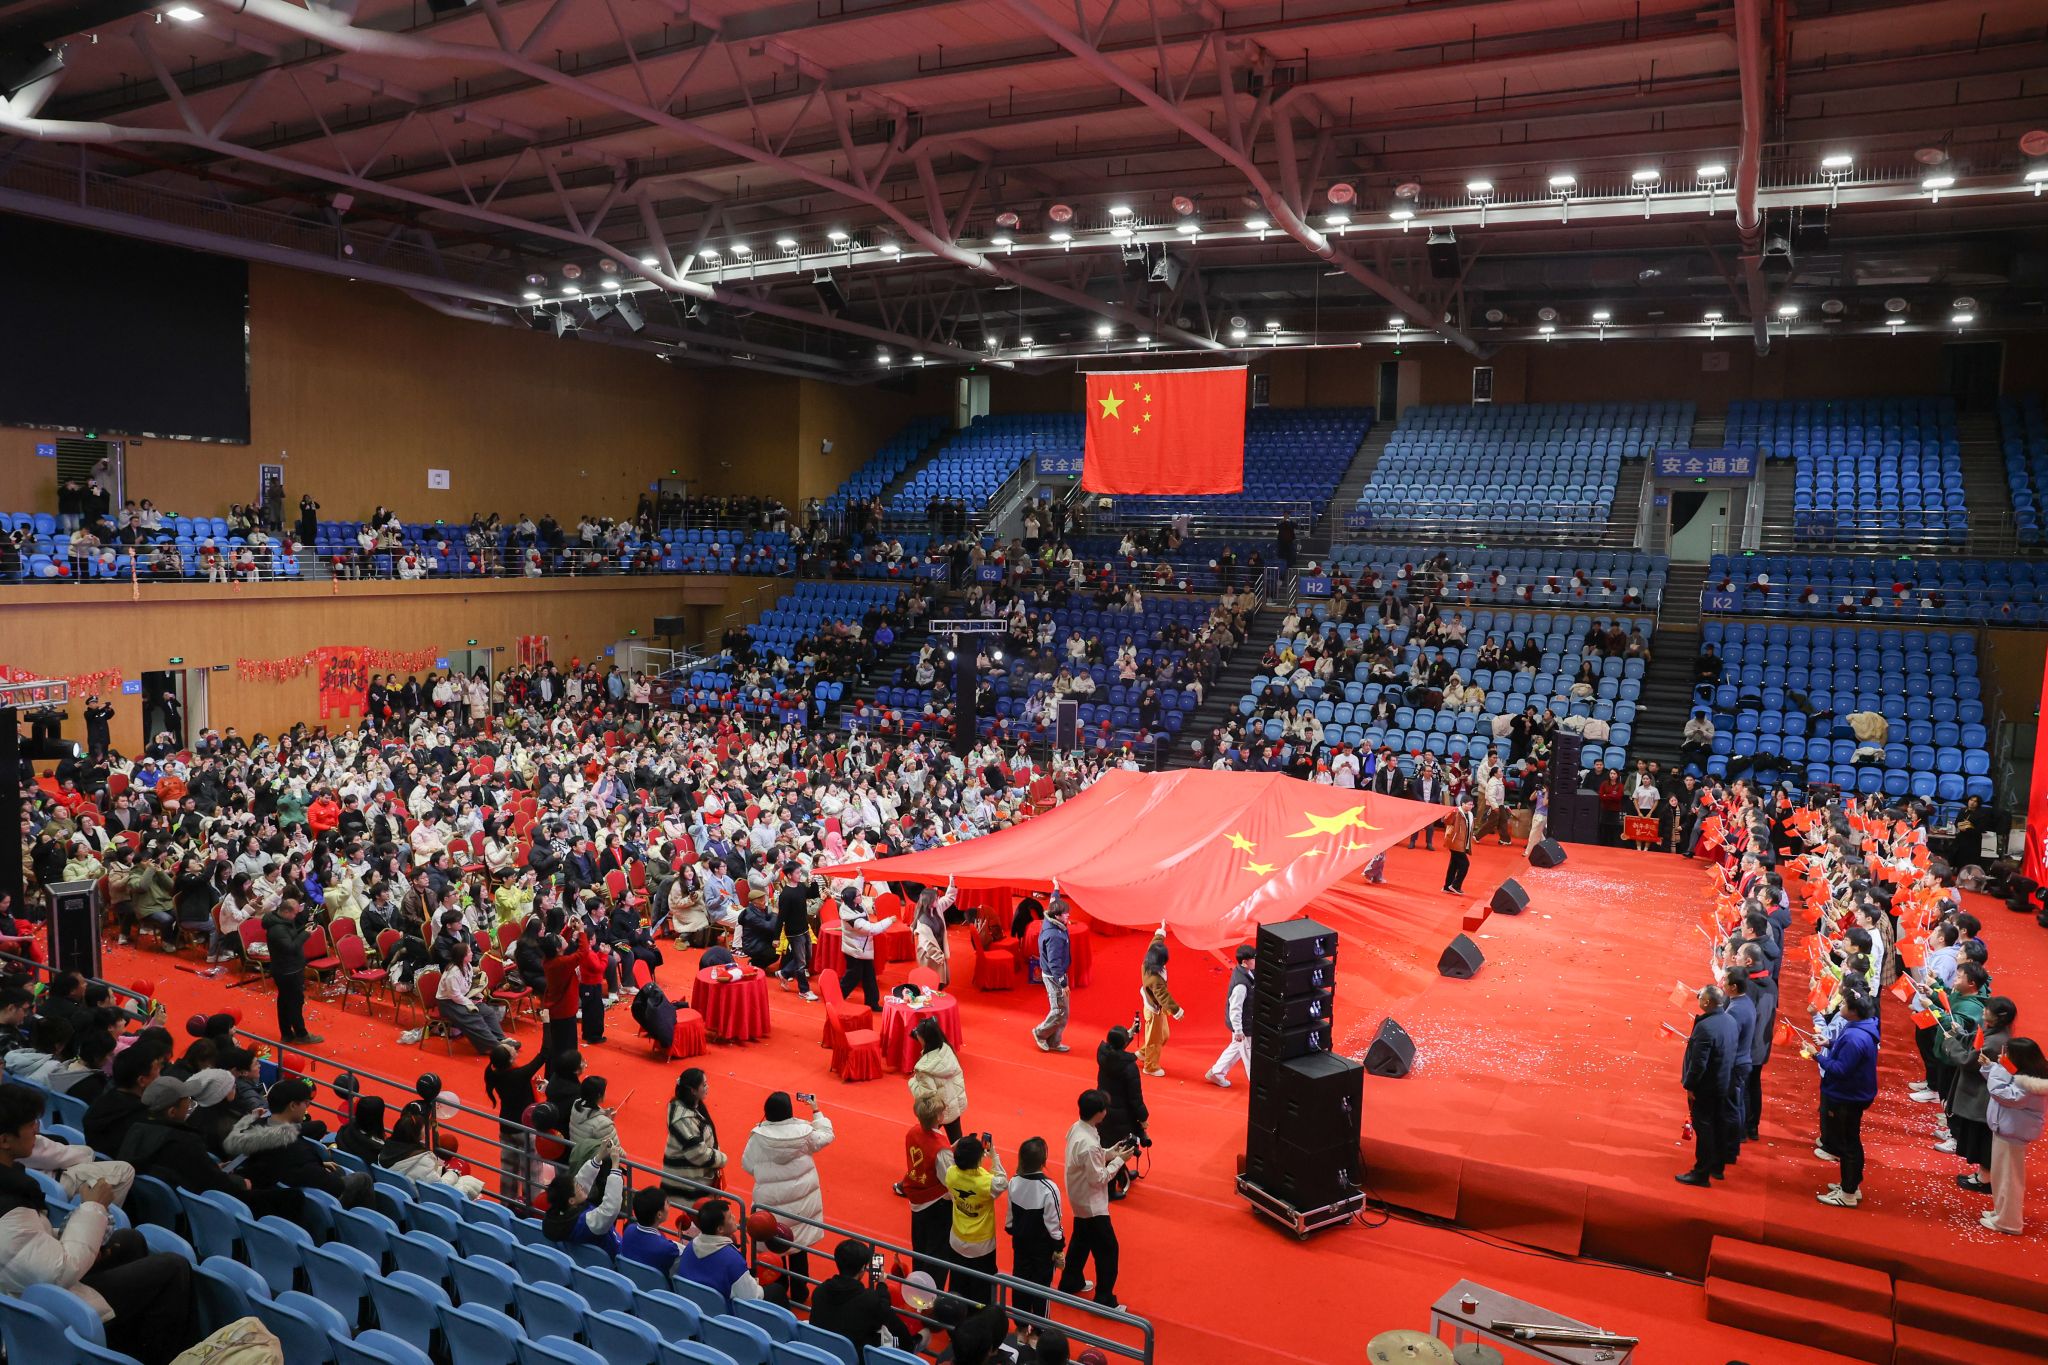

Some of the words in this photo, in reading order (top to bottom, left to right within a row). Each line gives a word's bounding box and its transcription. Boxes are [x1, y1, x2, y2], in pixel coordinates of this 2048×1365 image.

[1041, 459, 1084, 471] 安全通
[1662, 458, 1750, 473] 安全通道
[1350, 516, 1365, 525] H3
[1807, 525, 1825, 535] K3
[667, 560, 676, 568] E2
[983, 570, 996, 579] G2
[1307, 583, 1323, 592] H2
[1712, 598, 1732, 608] K2
[332, 656, 355, 670] 2026
